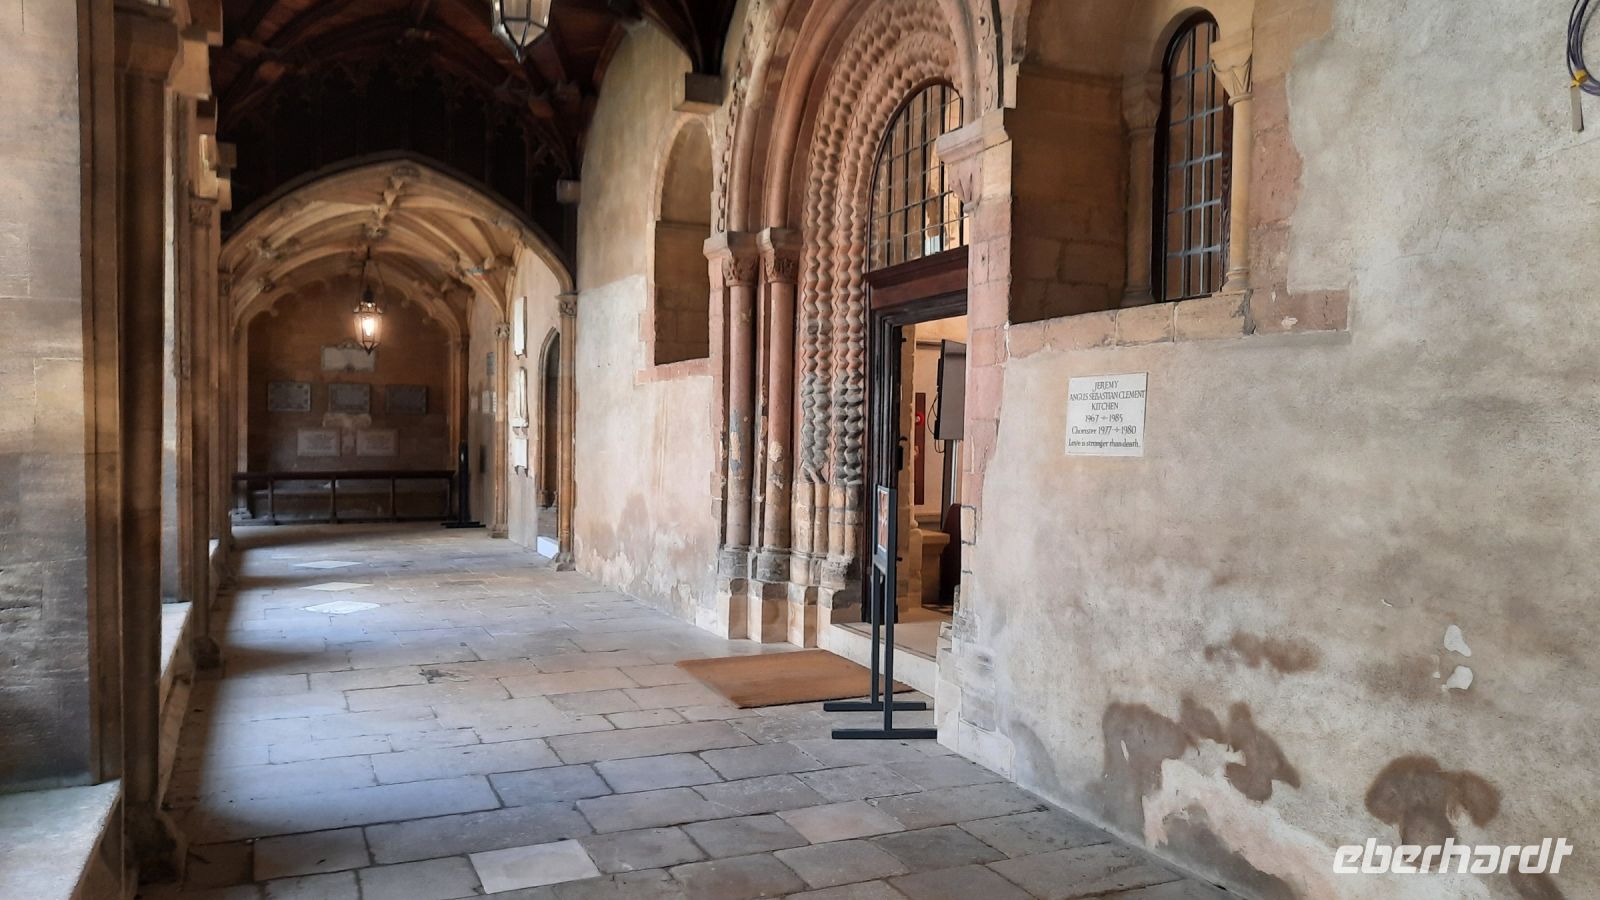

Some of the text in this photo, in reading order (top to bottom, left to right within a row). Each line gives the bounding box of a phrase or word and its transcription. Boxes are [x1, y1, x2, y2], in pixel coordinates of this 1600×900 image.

[1094, 380, 1119, 391] JEREMY
[1089, 391, 1118, 400] SEBASTIAN
[1118, 390, 1145, 399] CLEMENT
[1091, 402, 1119, 411] KITCHEN
[1109, 413, 1124, 423] 1985
[1098, 425, 1112, 435] 1977
[1121, 425, 1137, 434] 1980
